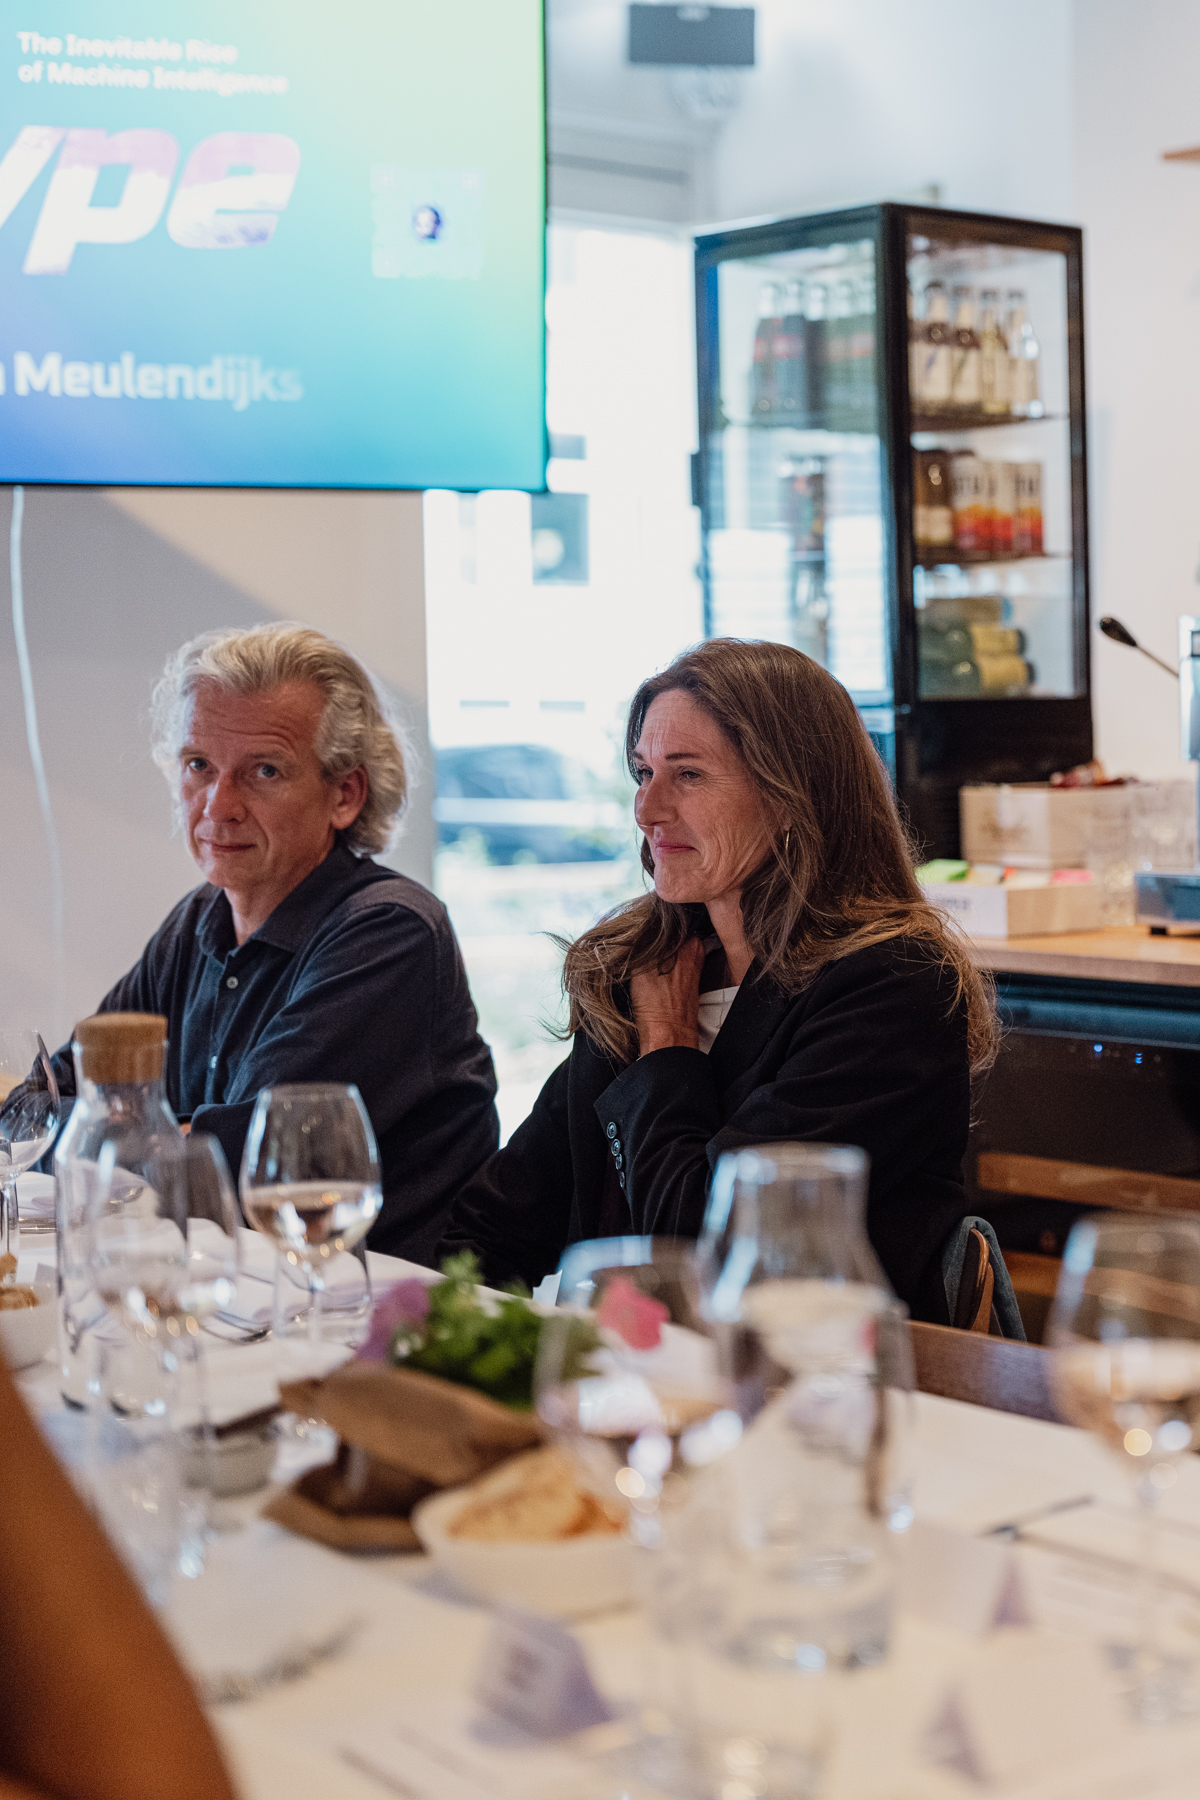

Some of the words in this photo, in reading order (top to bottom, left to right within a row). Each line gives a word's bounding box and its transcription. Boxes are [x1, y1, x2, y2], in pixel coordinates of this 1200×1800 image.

[16, 31, 63, 56] The
[65, 33, 183, 62] Inevitable
[185, 38, 239, 65] Rise
[18, 60, 44, 84] of
[47, 61, 150, 89] Machine
[152, 66, 289, 98] Intelligence
[13, 350, 304, 412] Meulendijks
